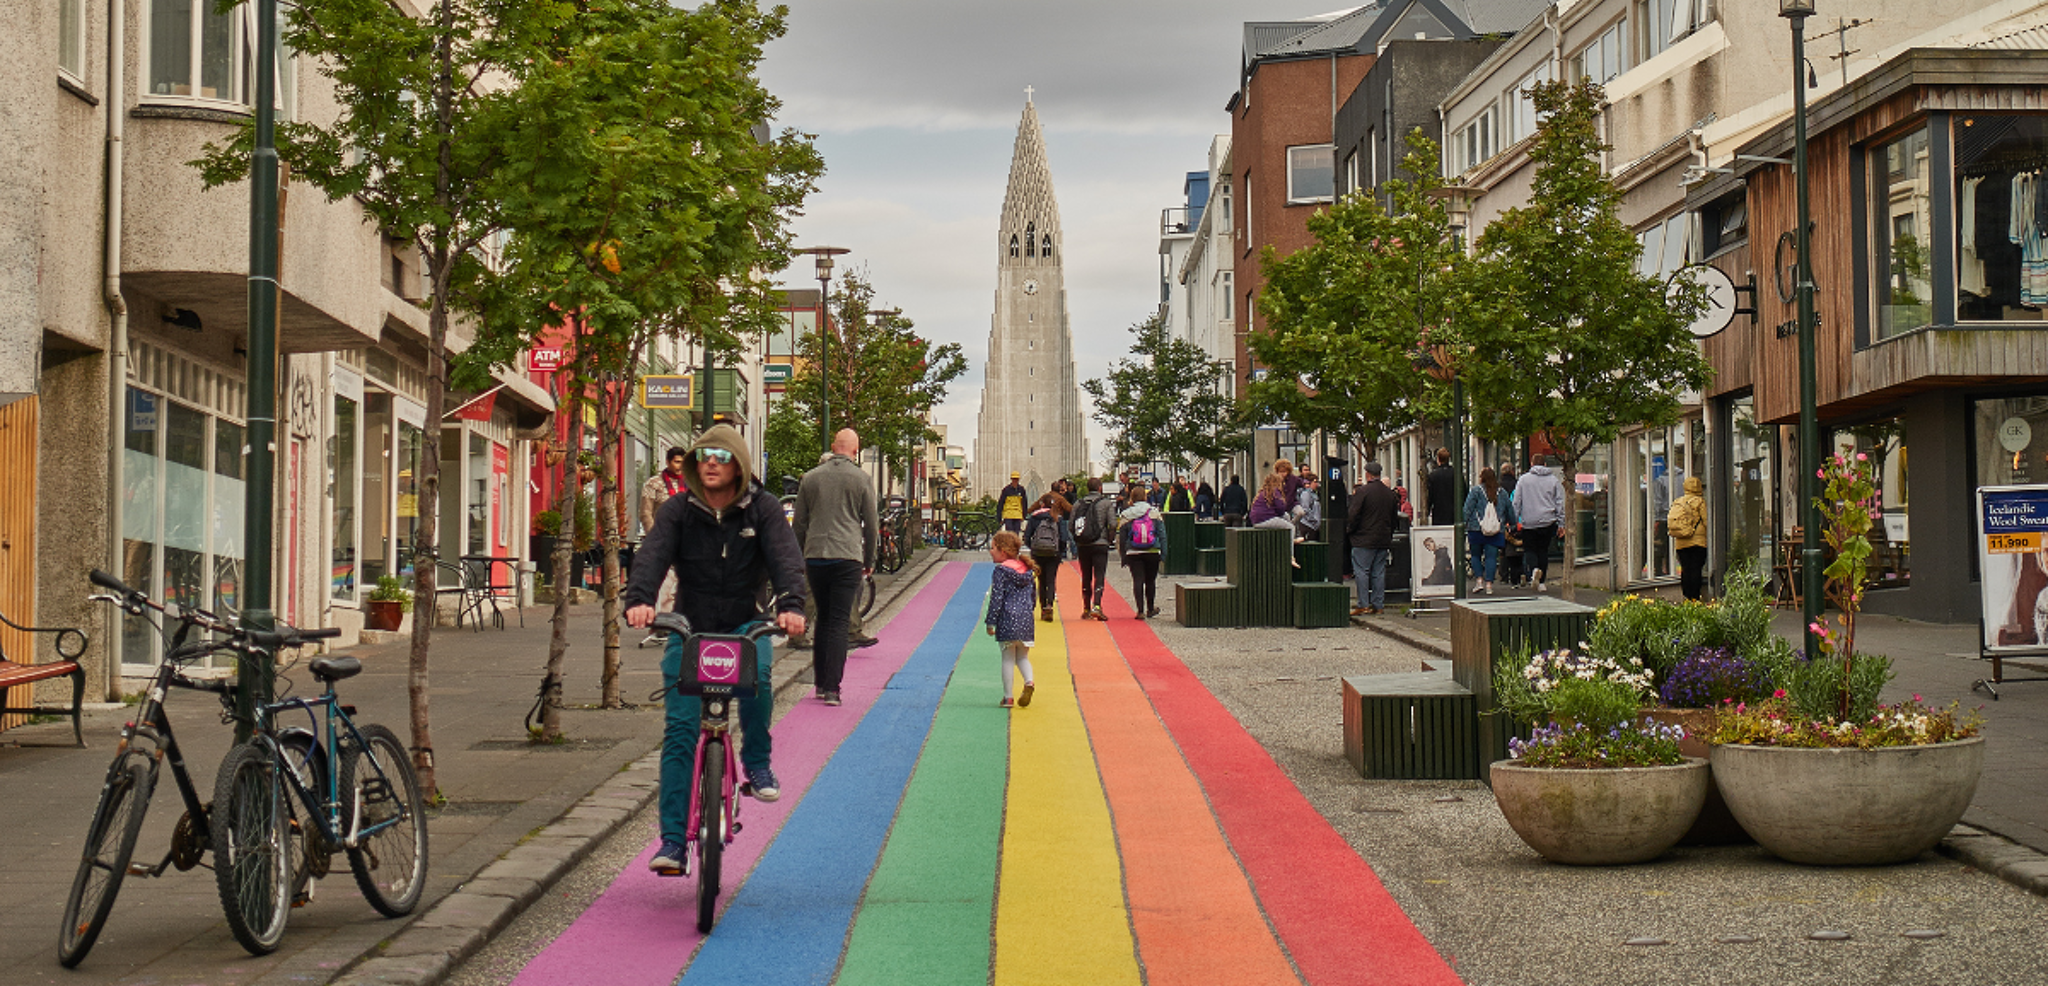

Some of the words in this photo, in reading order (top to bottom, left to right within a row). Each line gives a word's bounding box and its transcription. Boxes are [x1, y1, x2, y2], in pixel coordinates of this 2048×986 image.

[534, 350, 561, 361] ATM
[2007, 426, 2023, 436] GK
[1989, 503, 2036, 515] Icelandic
[1988, 515, 2018, 527] Wool
[702, 656, 735, 668] WOW
